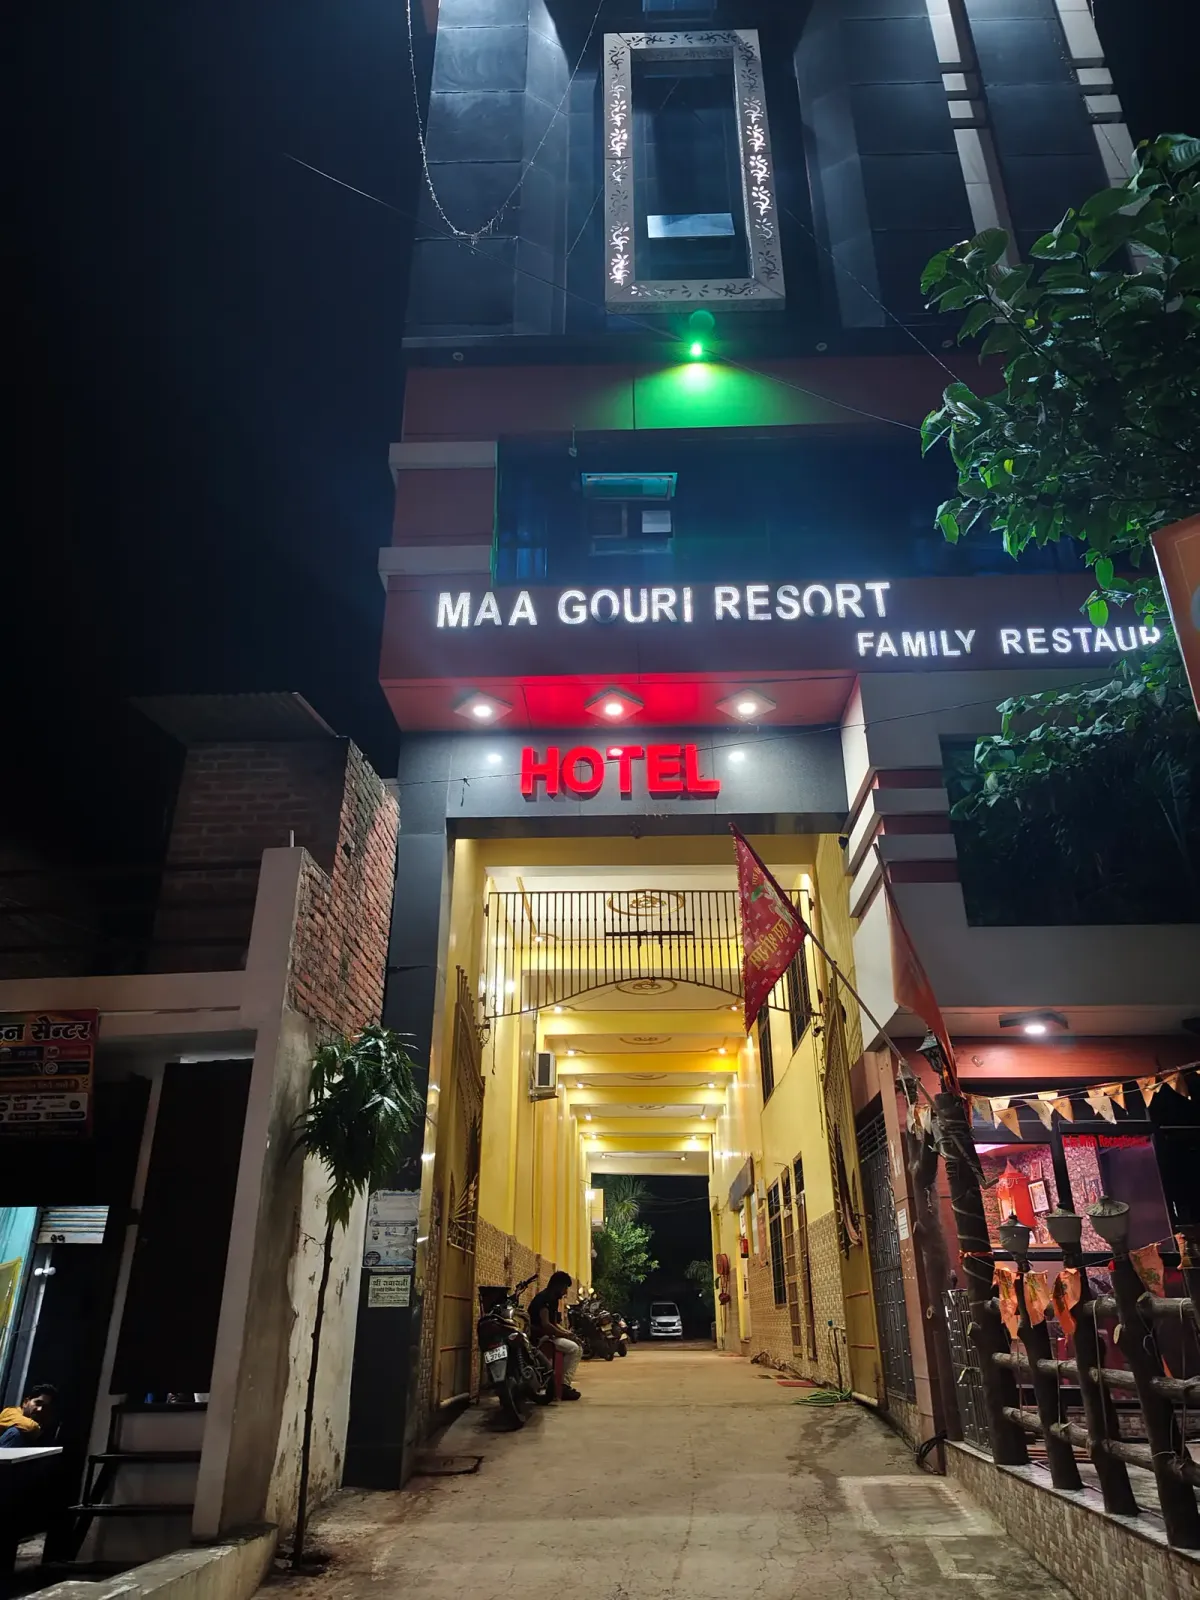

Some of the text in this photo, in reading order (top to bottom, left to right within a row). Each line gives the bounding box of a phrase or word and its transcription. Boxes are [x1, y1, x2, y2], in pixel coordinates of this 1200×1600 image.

[436, 581, 891, 628] MAA GOURI RESORT
[857, 629, 976, 657] FAMILY
[520, 743, 721, 800] HOTEL
